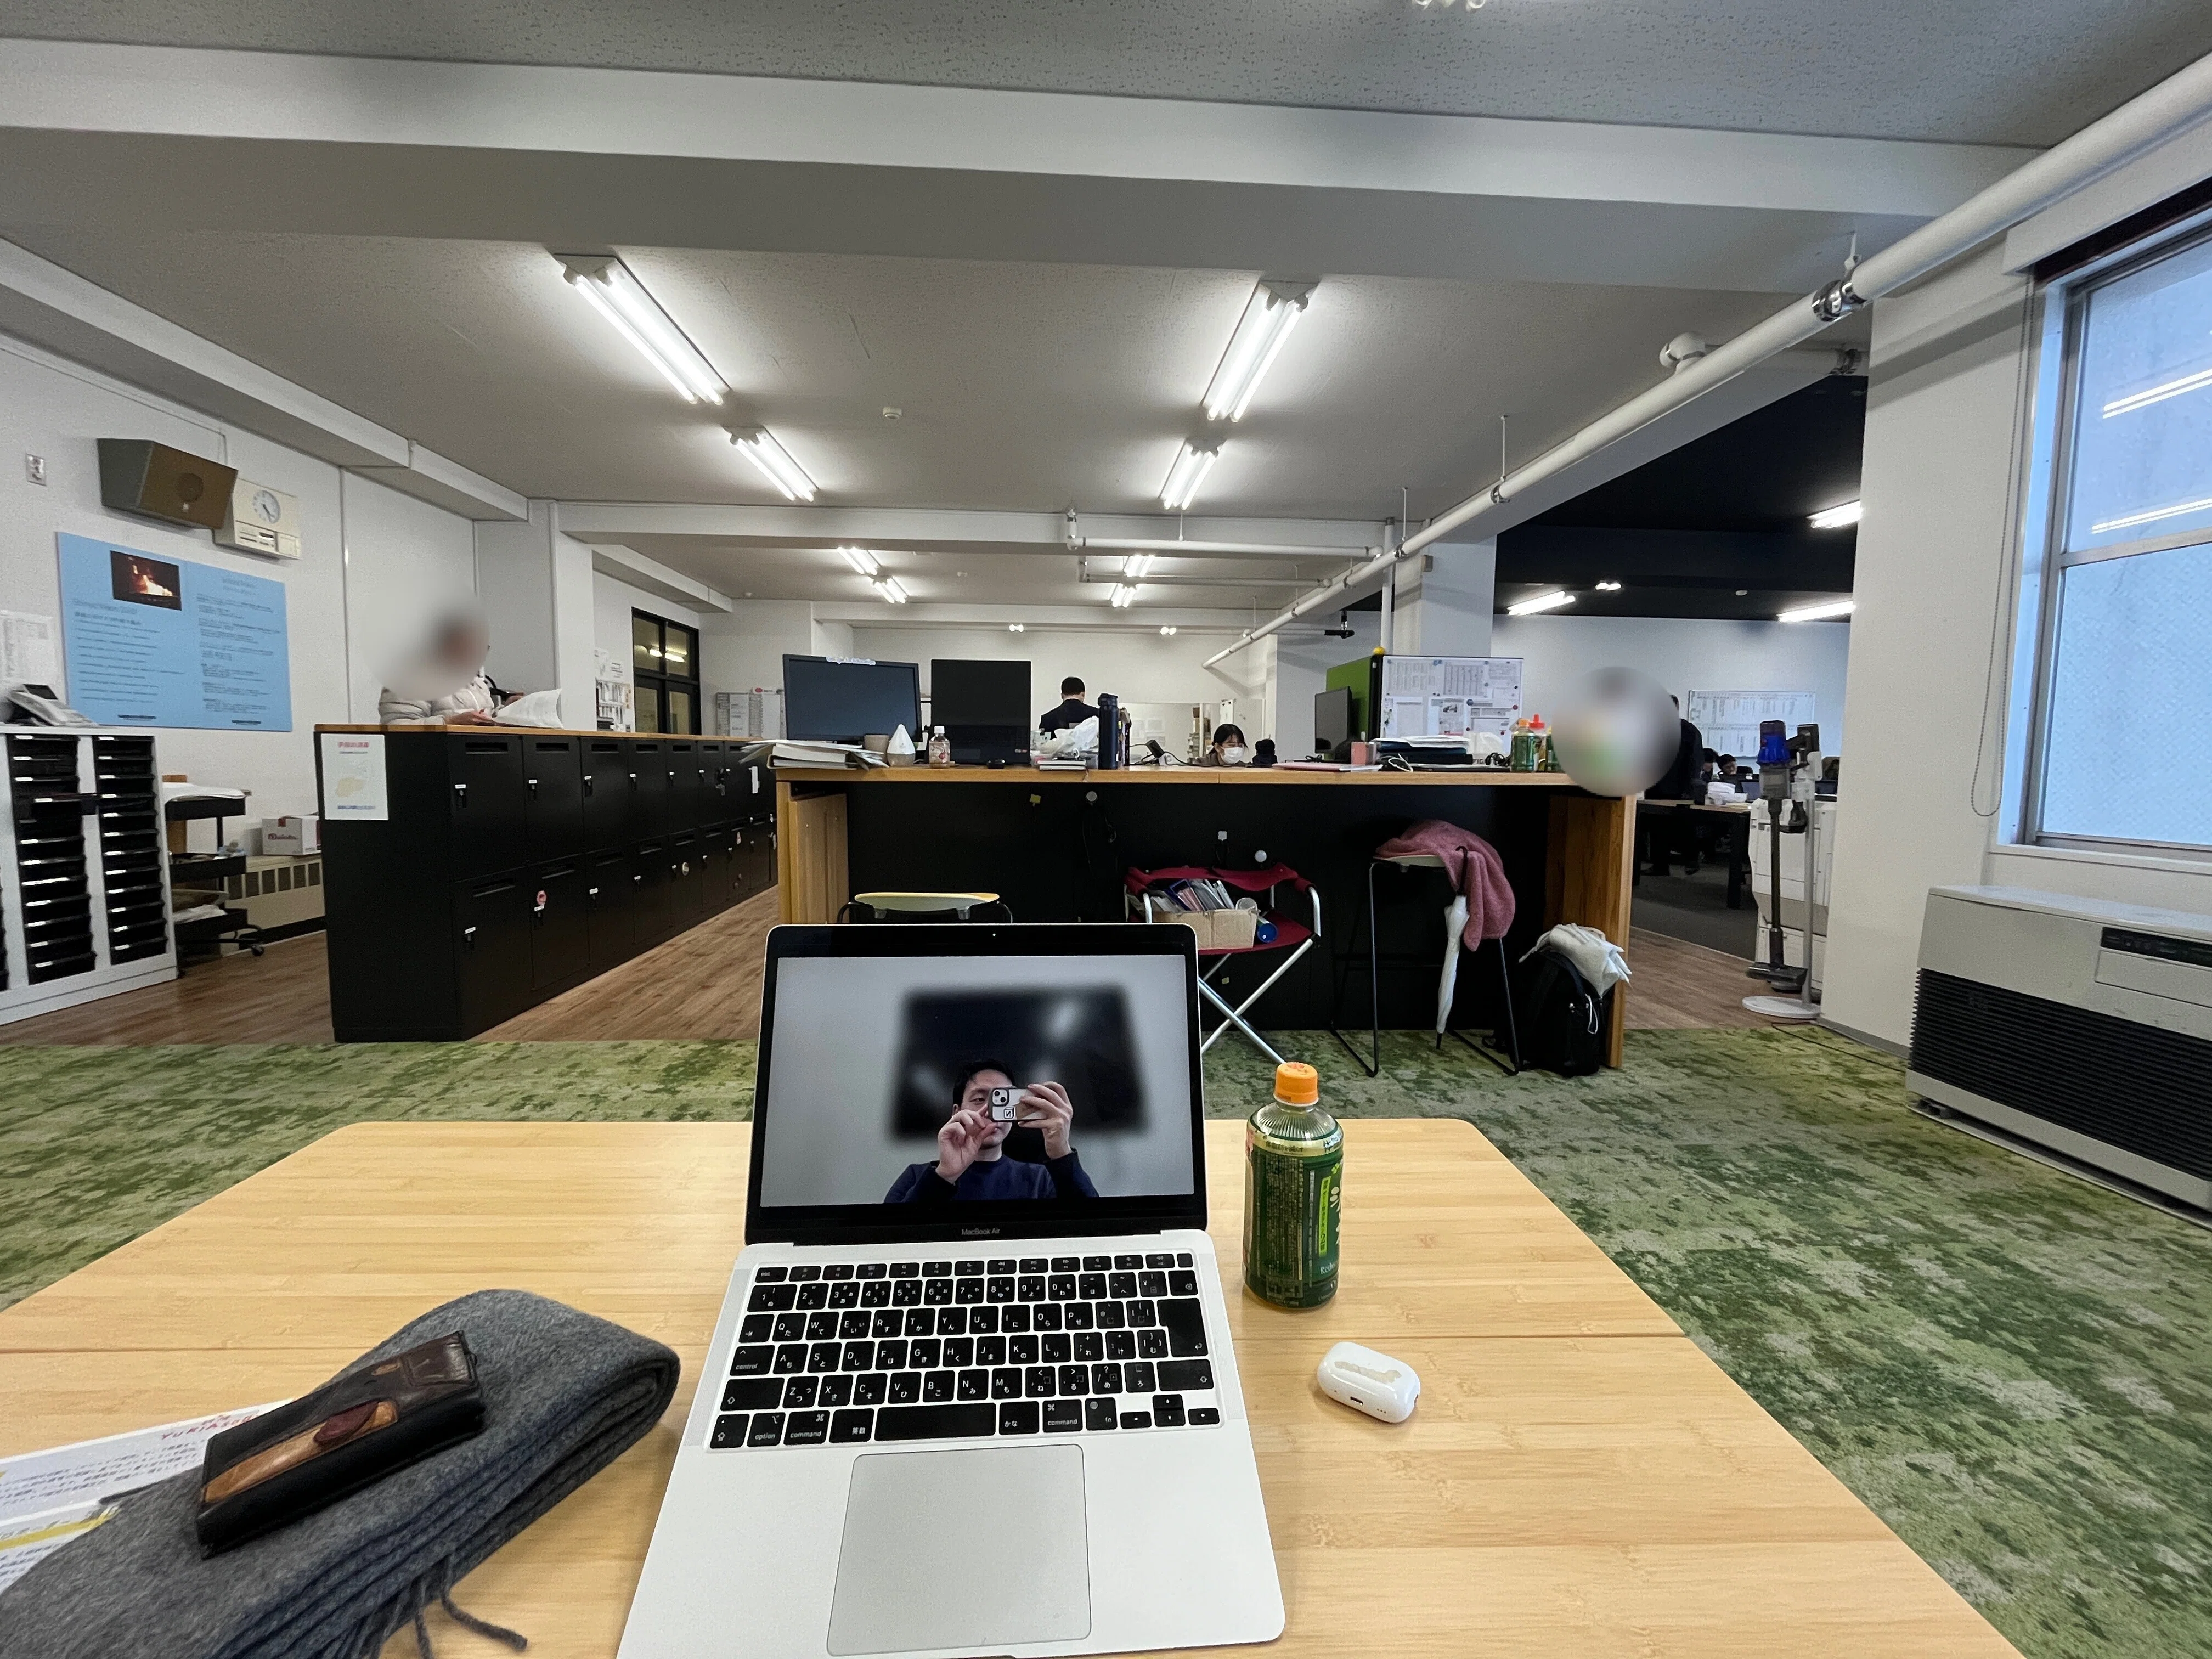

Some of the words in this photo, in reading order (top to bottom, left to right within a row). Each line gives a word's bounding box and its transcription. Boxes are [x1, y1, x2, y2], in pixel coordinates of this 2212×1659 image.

[778, 1323, 785, 1331] Q
[844, 1320, 849, 1328] E
[847, 1351, 854, 1359] D
[914, 1348, 921, 1357] G
[928, 1381, 934, 1390] B
[962, 1380, 969, 1388] N
[996, 1378, 1003, 1386] M
[789, 1387, 796, 1396] Z
[825, 1386, 832, 1394] X
[859, 1384, 866, 1393] C
[754, 1432, 776, 1441] option
[790, 1430, 822, 1438] command
